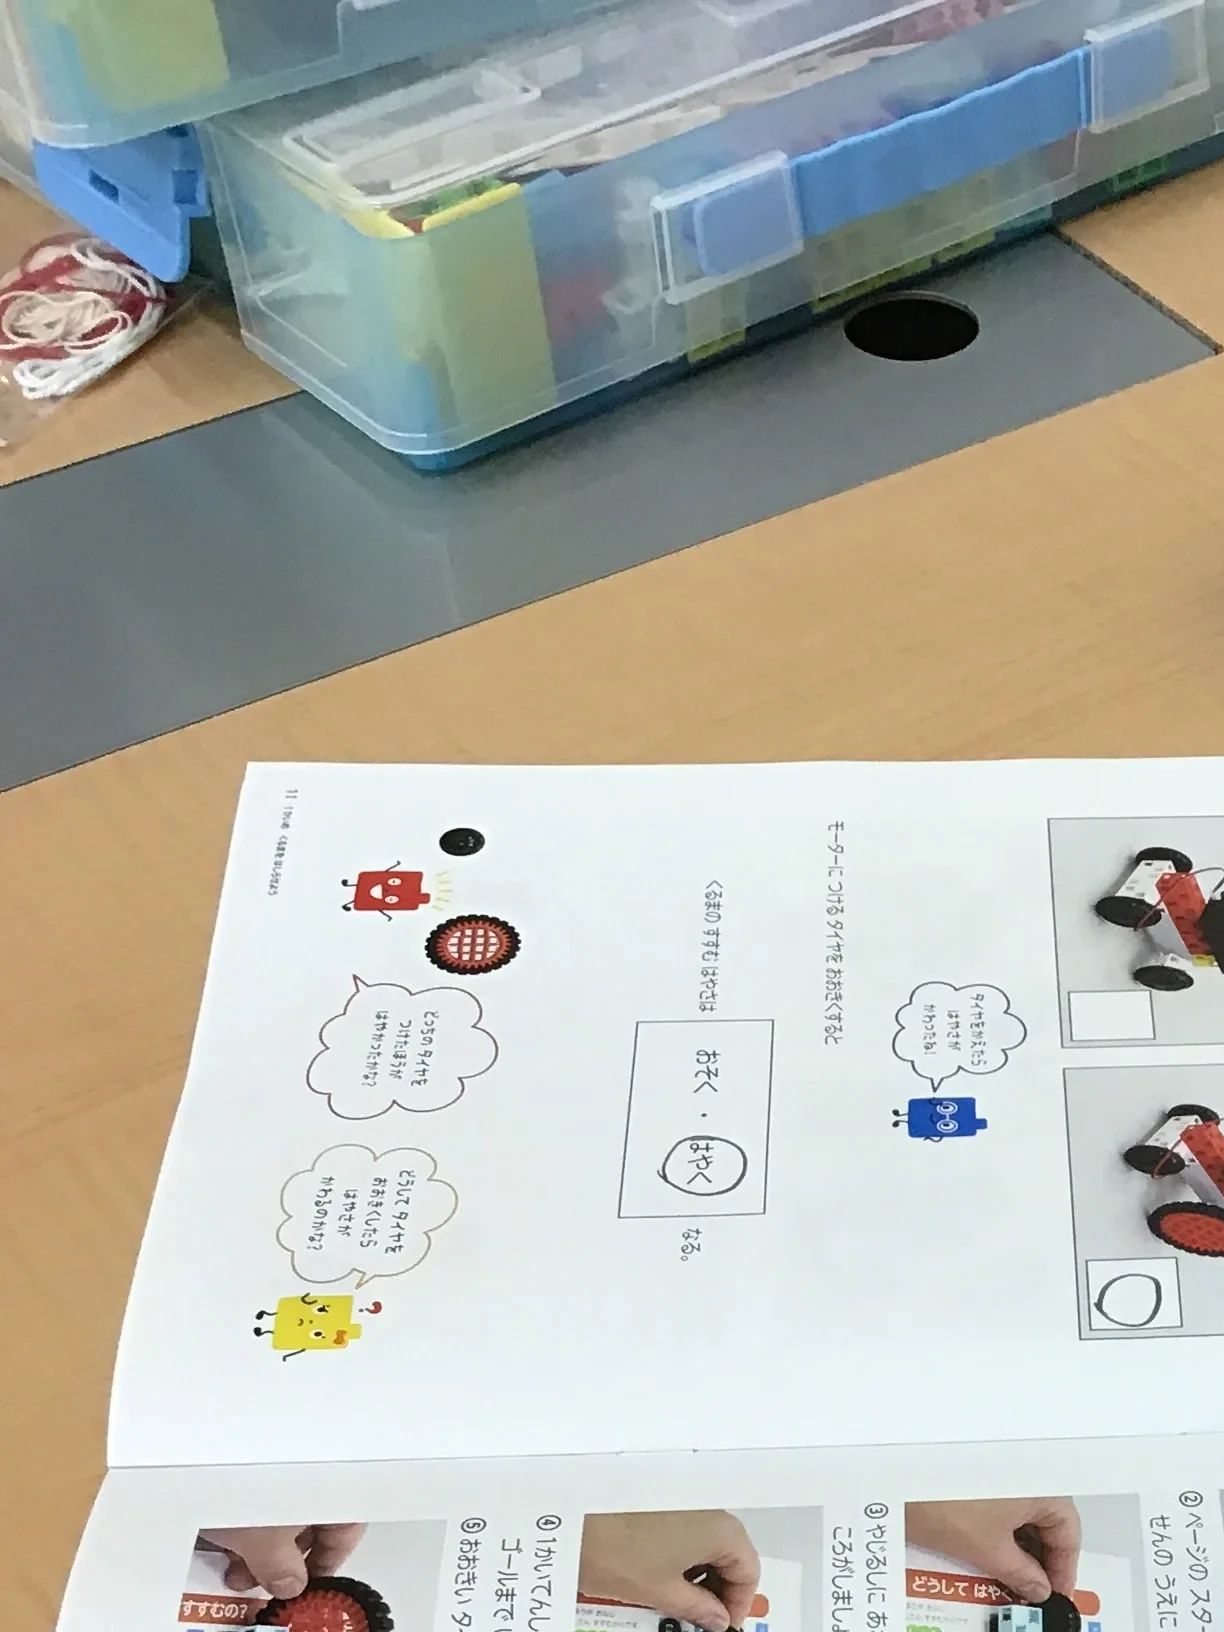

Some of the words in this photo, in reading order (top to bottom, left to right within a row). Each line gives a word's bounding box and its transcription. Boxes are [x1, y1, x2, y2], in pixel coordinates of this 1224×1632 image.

[827, 821, 845, 878] モーターに
[703, 879, 723, 924] くるまの
[826, 881, 844, 917] つける
[701, 927, 722, 962] すすむ
[826, 919, 844, 964] タイヤを
[698, 966, 720, 1013] はやさは
[824, 967, 843, 1046] おおきくすると
[693, 1049, 722, 1094] おそく
[685, 1138, 715, 1186] はやく
[394, 1169, 416, 1207] どうして
[337, 1189, 359, 1237] はやさが
[359, 1177, 388, 1249] おおきくしたら
[384, 1211, 409, 1255] タイヤを
[679, 1227, 703, 1263] なる。
[1149, 1514, 1174, 1567] せんの
[493, 1538, 523, 1621] ゴールまで
[1154, 1574, 1178, 1629] うえに
